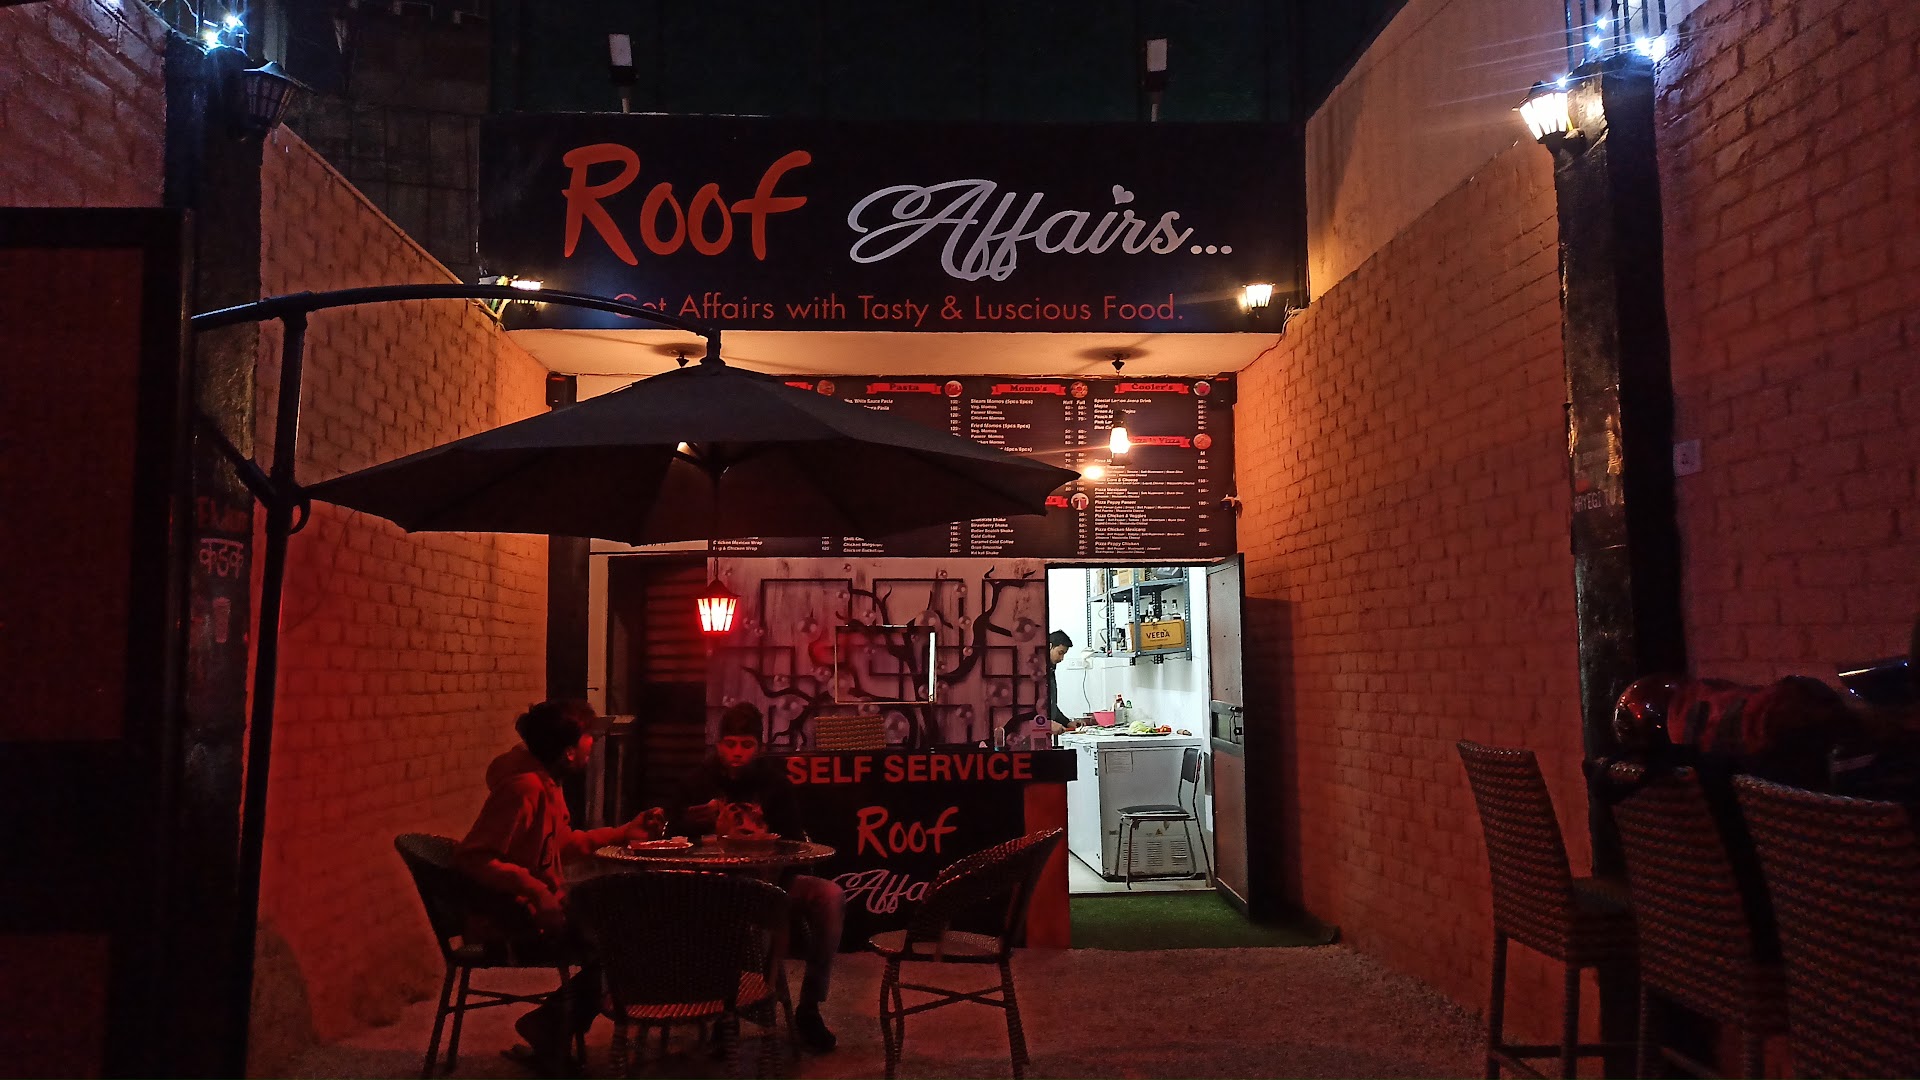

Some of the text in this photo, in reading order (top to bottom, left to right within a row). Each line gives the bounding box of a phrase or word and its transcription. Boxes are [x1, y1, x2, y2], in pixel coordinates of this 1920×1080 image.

[562, 143, 1232, 281] Roof Affairs...
[679, 292, 774, 320] Affairs
[786, 292, 846, 320] with
[858, 295, 929, 327] Tasty
[941, 296, 962, 320] &
[975, 295, 1091, 320] Luscious
[1104, 293, 1184, 320] Food.
[889, 382, 920, 391] Pasta
[1010, 384, 1048, 392] Momo's
[1131, 383, 1174, 391] Cooler's
[786, 753, 1033, 784] SELF SERVICE
[830, 805, 959, 914] Roof Affa
